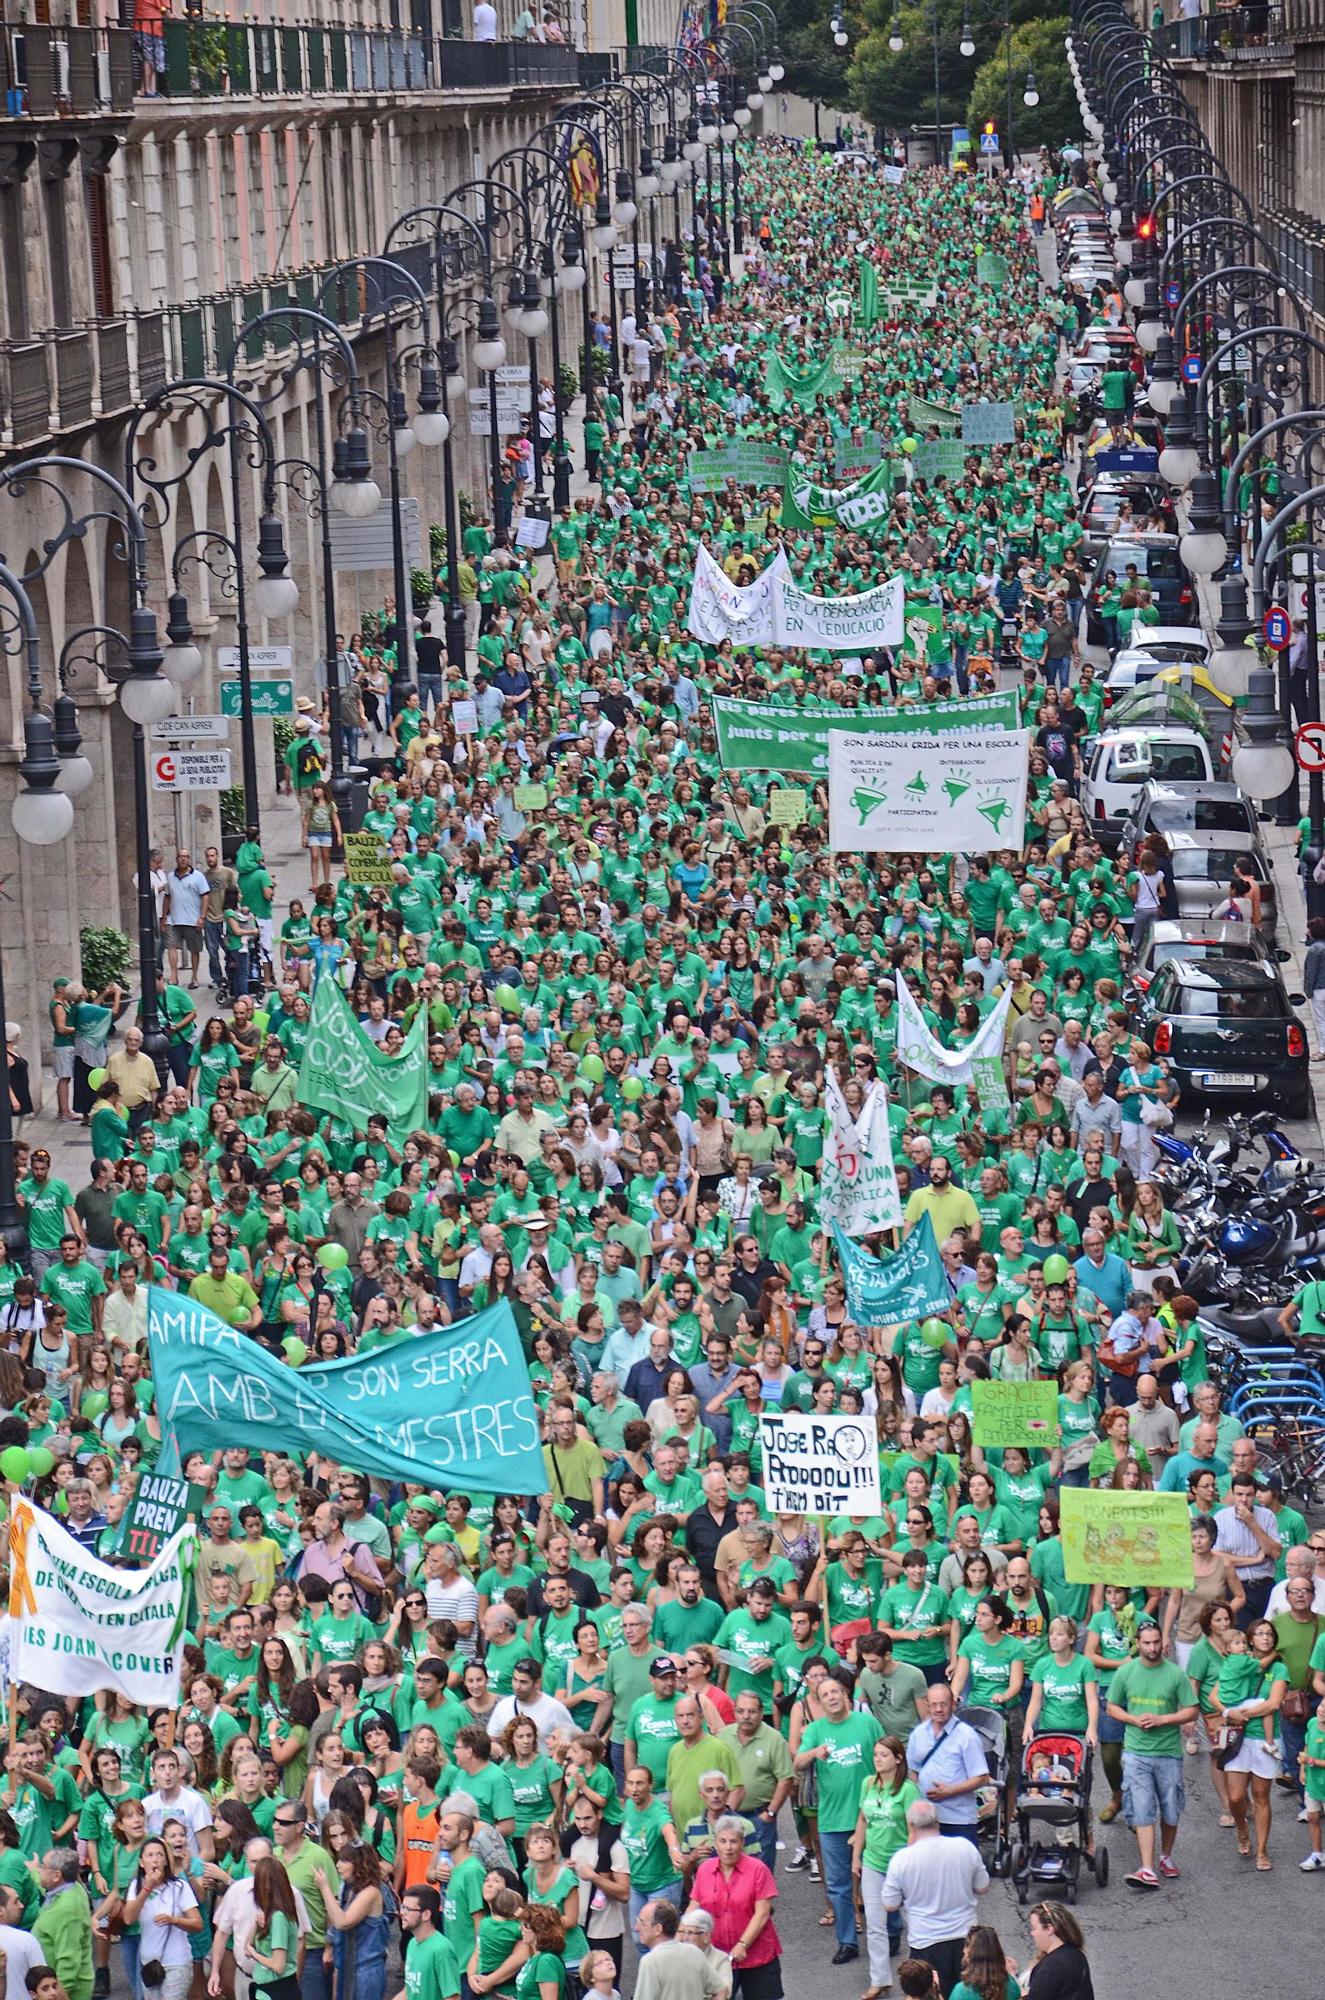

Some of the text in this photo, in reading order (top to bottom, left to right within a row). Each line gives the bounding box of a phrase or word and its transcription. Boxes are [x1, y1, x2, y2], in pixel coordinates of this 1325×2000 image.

[786, 617, 803, 631] EN
[747, 705, 799, 718] pares
[935, 696, 1012, 713] docents,
[727, 724, 773, 740] junts
[778, 729, 810, 743] per
[843, 739, 864, 747] SON
[867, 740, 908, 748] SARDINA
[911, 740, 940, 749] CRIDA
[943, 740, 960, 749] PER
[963, 739, 982, 748] UNA
[865, 1165, 892, 1181] UNA
[902, 1306, 920, 1319] SON
[150, 1310, 241, 1349] AMIPA
[342, 1362, 400, 1402] SON
[411, 1337, 508, 1389] SERRA
[167, 1372, 277, 1422] AMB
[134, 1502, 178, 1534] PREN
[79, 1571, 132, 1601] ESCOLA
[36, 1571, 54, 1588] DE
[106, 1613, 125, 1627] EN
[24, 1626, 46, 1647] IES
[53, 1632, 96, 1655] JOAN
